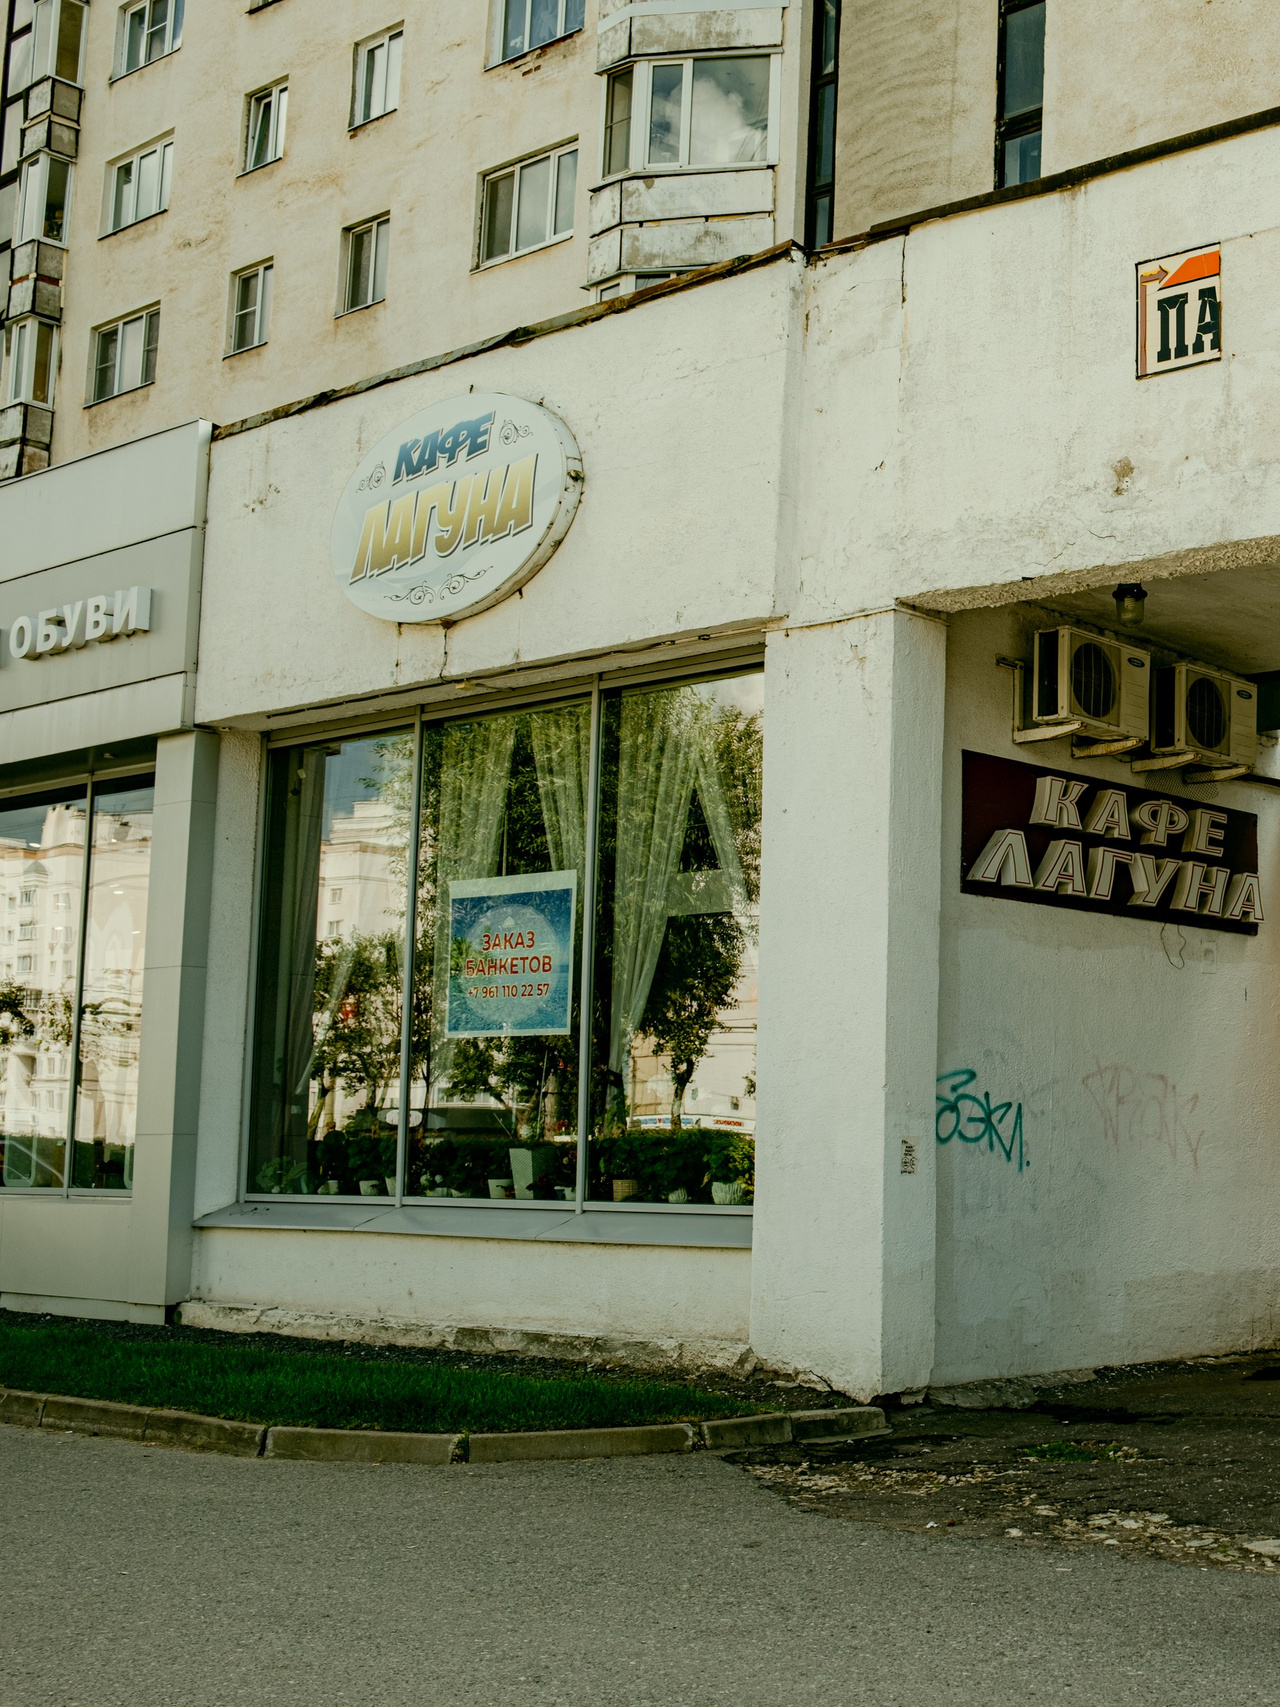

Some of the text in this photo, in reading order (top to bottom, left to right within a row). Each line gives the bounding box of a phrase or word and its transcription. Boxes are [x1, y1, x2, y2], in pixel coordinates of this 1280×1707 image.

[392, 411, 496, 486] КАФЕ
[350, 453, 539, 586] ЛАГУНА
[9, 586, 151, 660] ОБУВИ
[1028, 775, 1228, 857] КАФЕ
[966, 828, 1265, 923] ЛАГУНА
[465, 955, 552, 977] БАНКЕТОВ
[482, 930, 535, 951] ЗАКАЗ
[468, 983, 550, 999] +7 961 110 22 57
